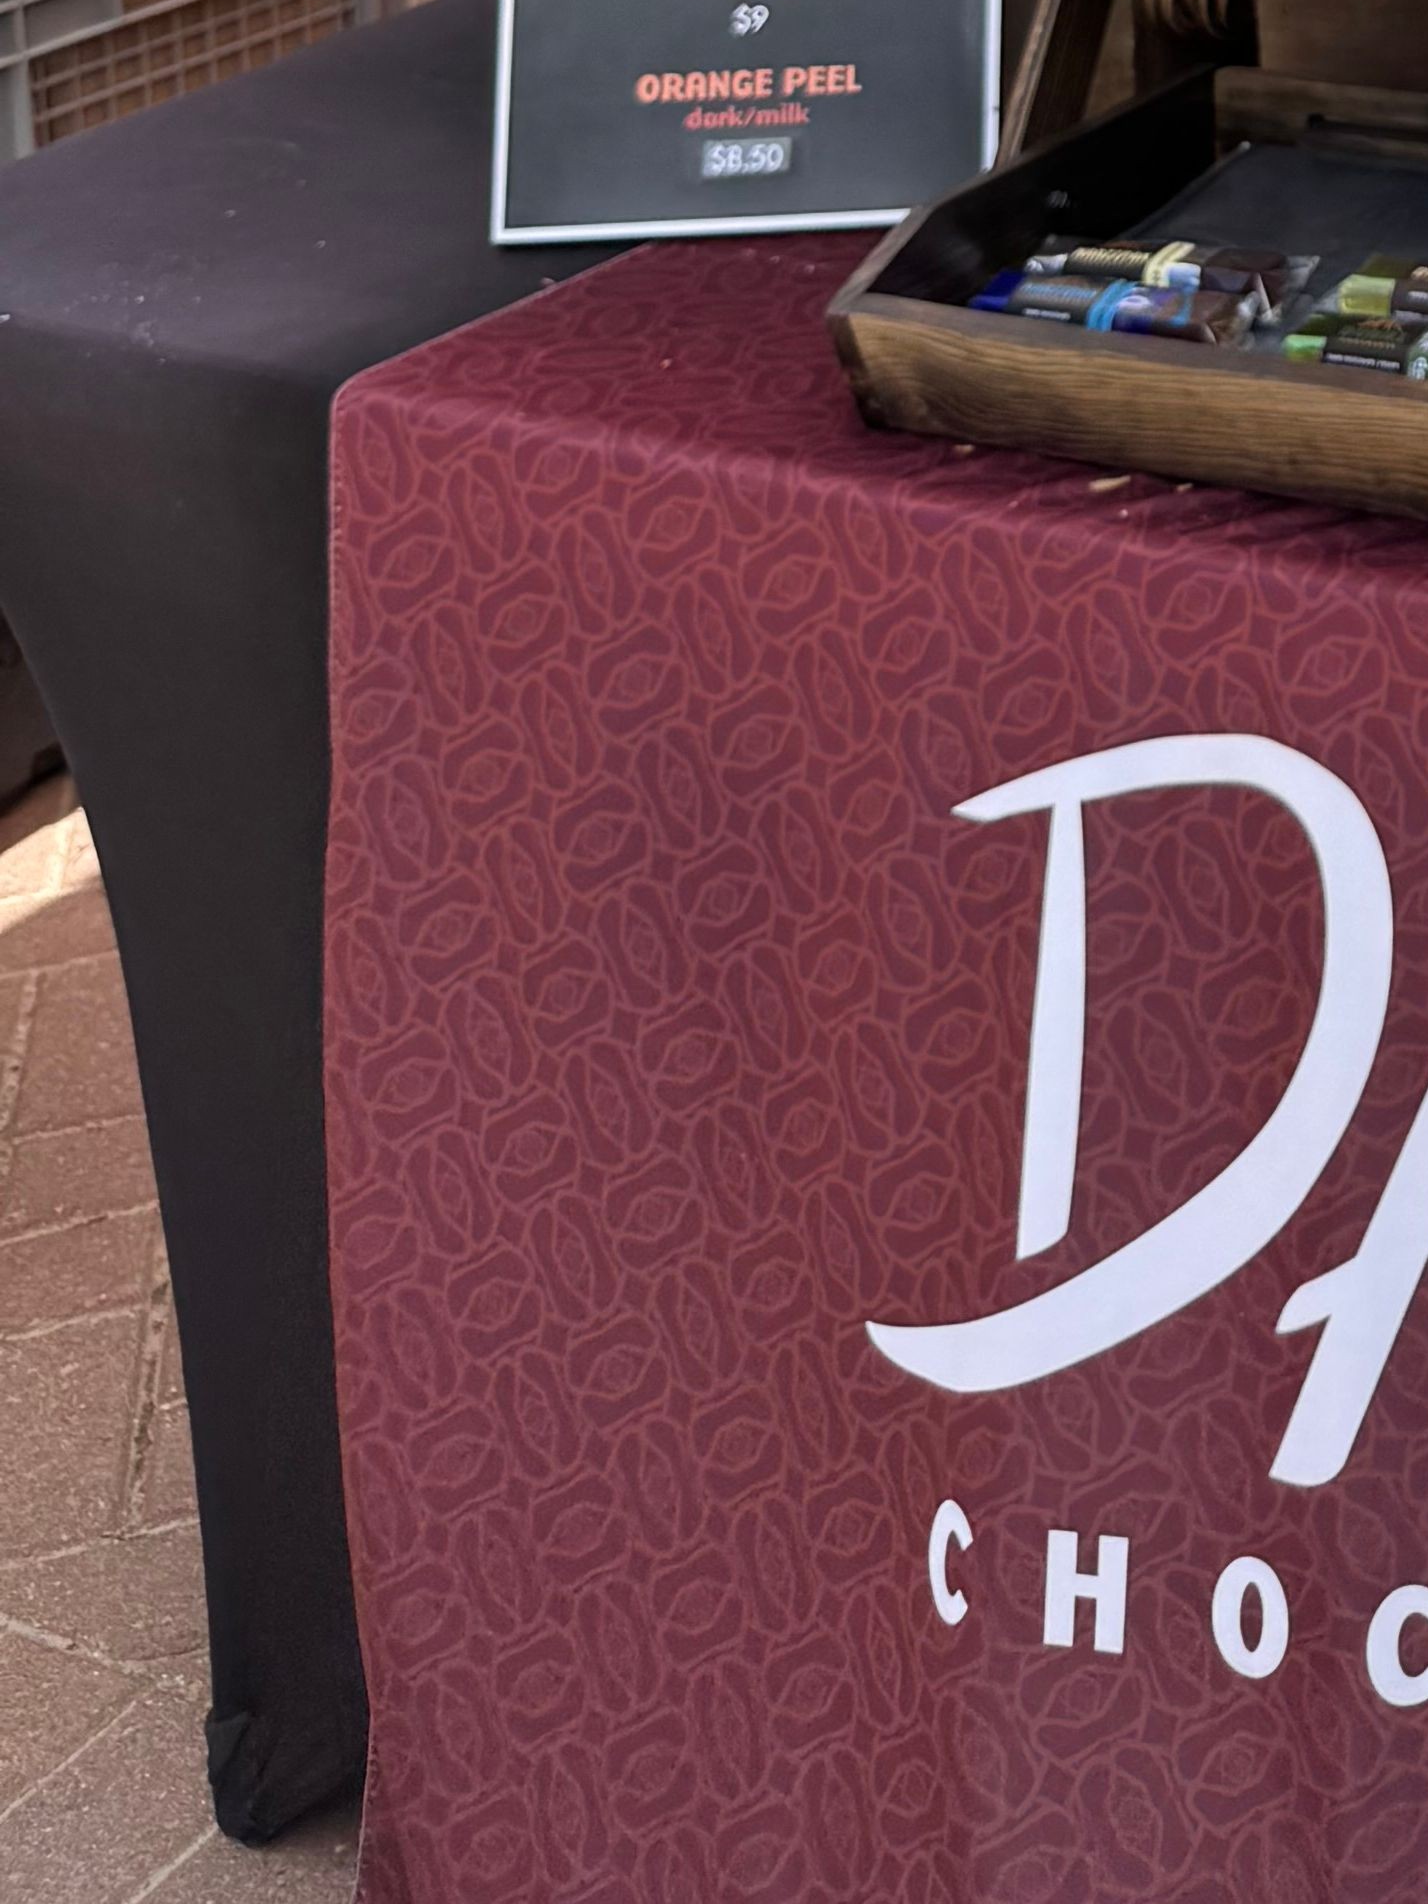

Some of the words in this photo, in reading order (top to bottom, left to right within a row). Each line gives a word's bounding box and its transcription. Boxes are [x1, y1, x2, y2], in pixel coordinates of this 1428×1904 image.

[730, 2, 770, 37] $9
[636, 68, 773, 105] ORANGE
[781, 64, 863, 98] PEEL
[683, 102, 810, 131] dark/milk
